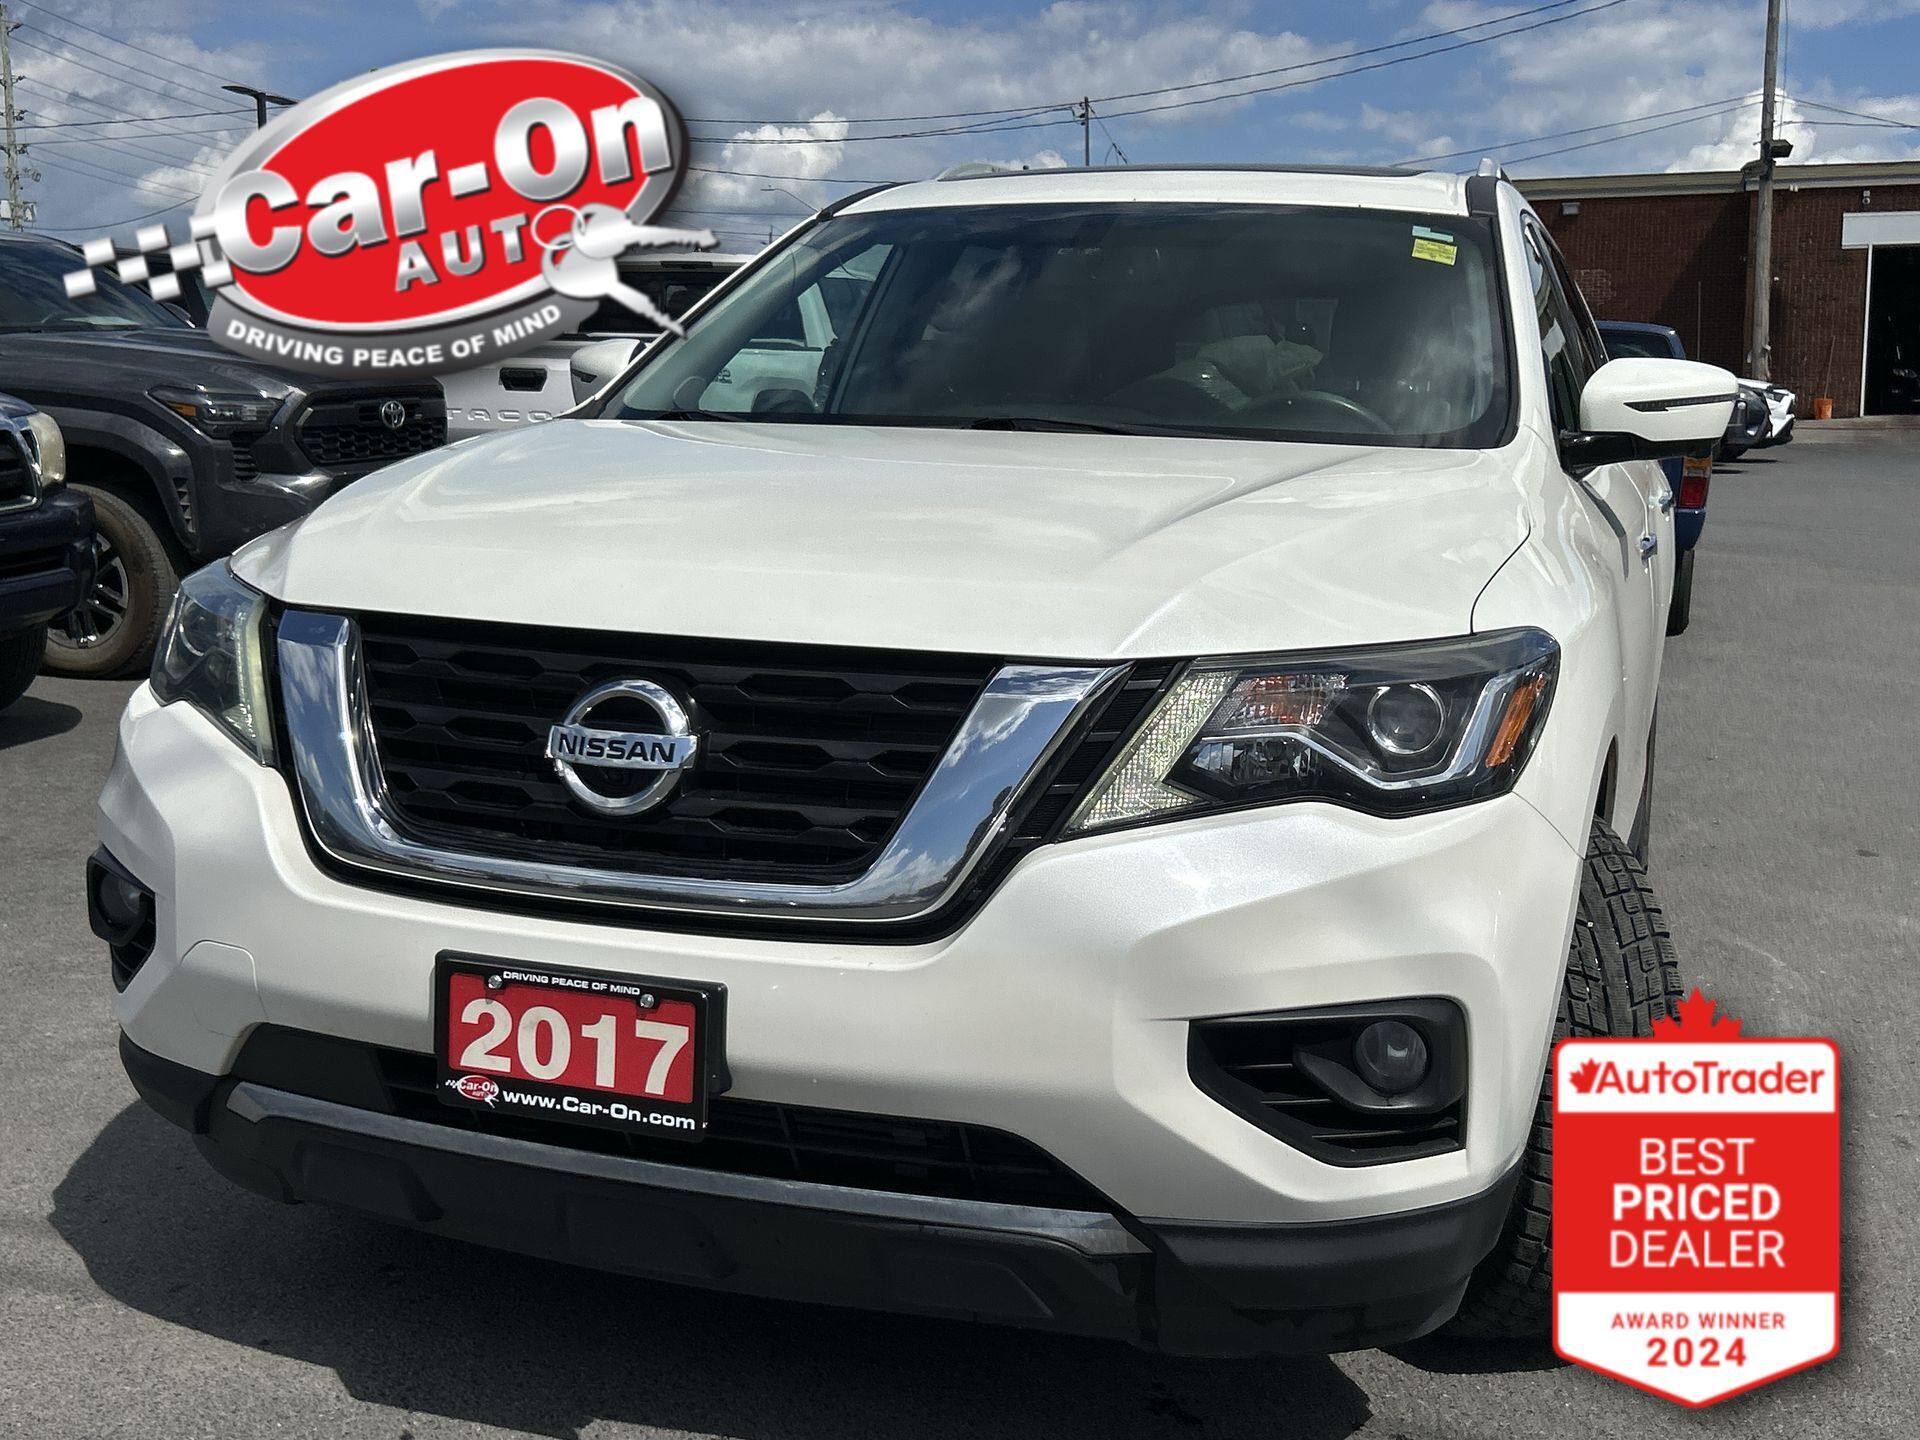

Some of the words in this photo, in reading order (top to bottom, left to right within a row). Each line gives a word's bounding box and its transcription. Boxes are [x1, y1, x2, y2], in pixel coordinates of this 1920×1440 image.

[447, 407, 560, 423] TACO
[558, 733, 676, 763] NISSAN
[503, 971, 549, 984] DRIVING
[552, 977, 589, 989] PEACE
[592, 982, 608, 990] OF
[610, 985, 640, 995] MIND
[459, 998, 690, 1095] 2017
[460, 1080, 497, 1092] Car-On
[502, 1090, 696, 1130] www.Car-On.com
